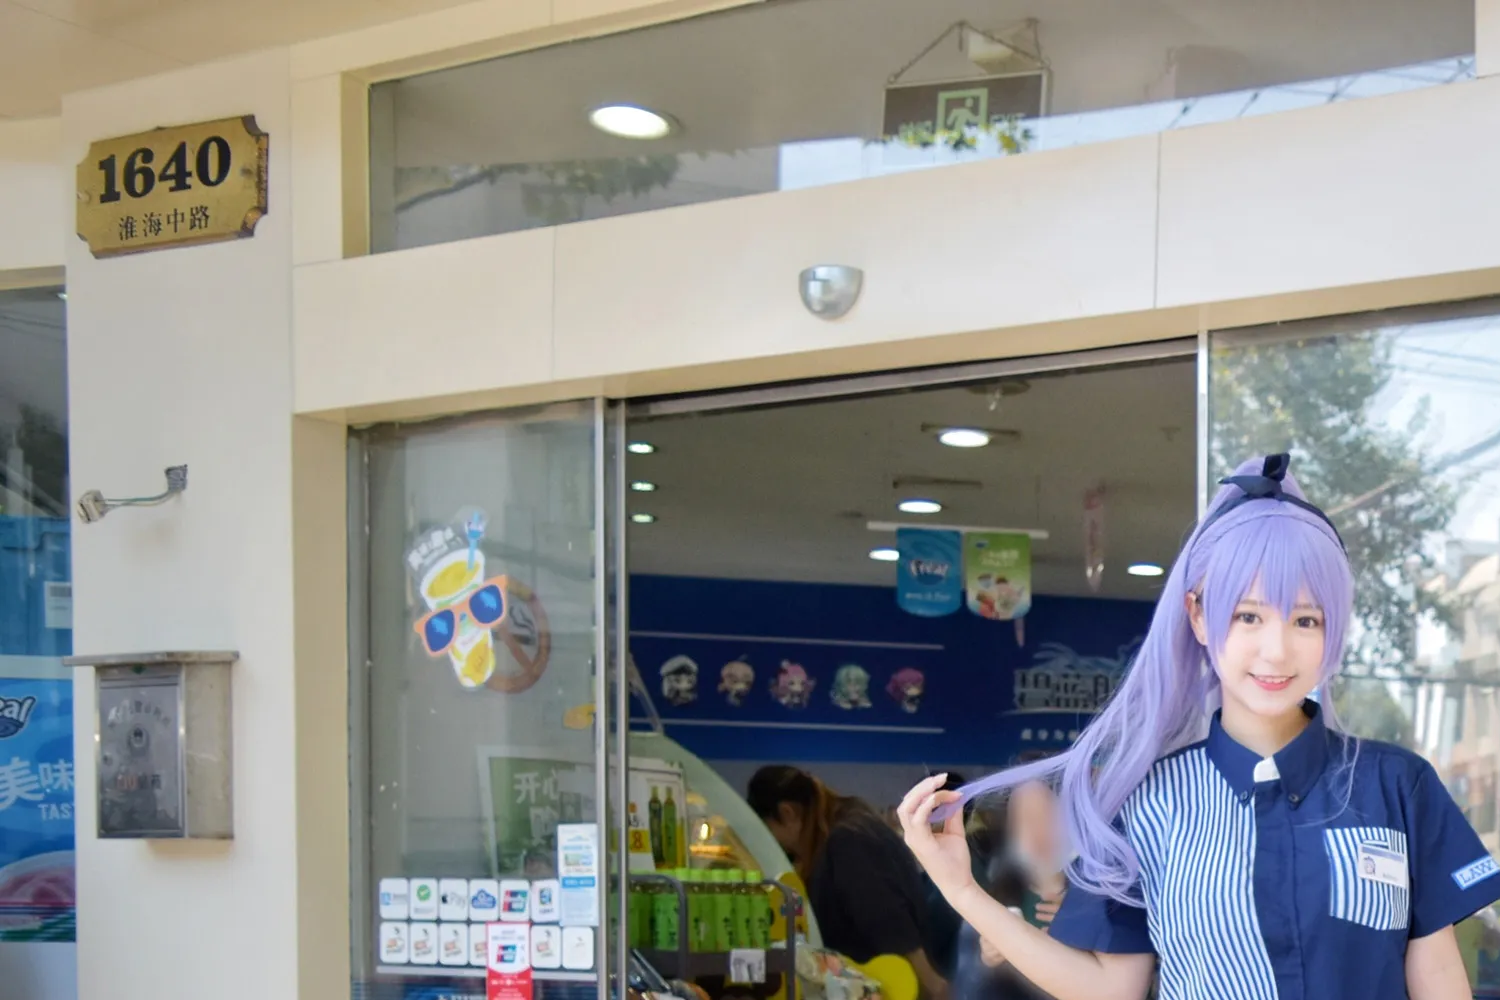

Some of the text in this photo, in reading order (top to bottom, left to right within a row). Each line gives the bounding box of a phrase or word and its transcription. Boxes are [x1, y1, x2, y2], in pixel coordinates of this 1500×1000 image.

[98, 135, 232, 204] 1640
[119, 205, 211, 241] 淮海中路
